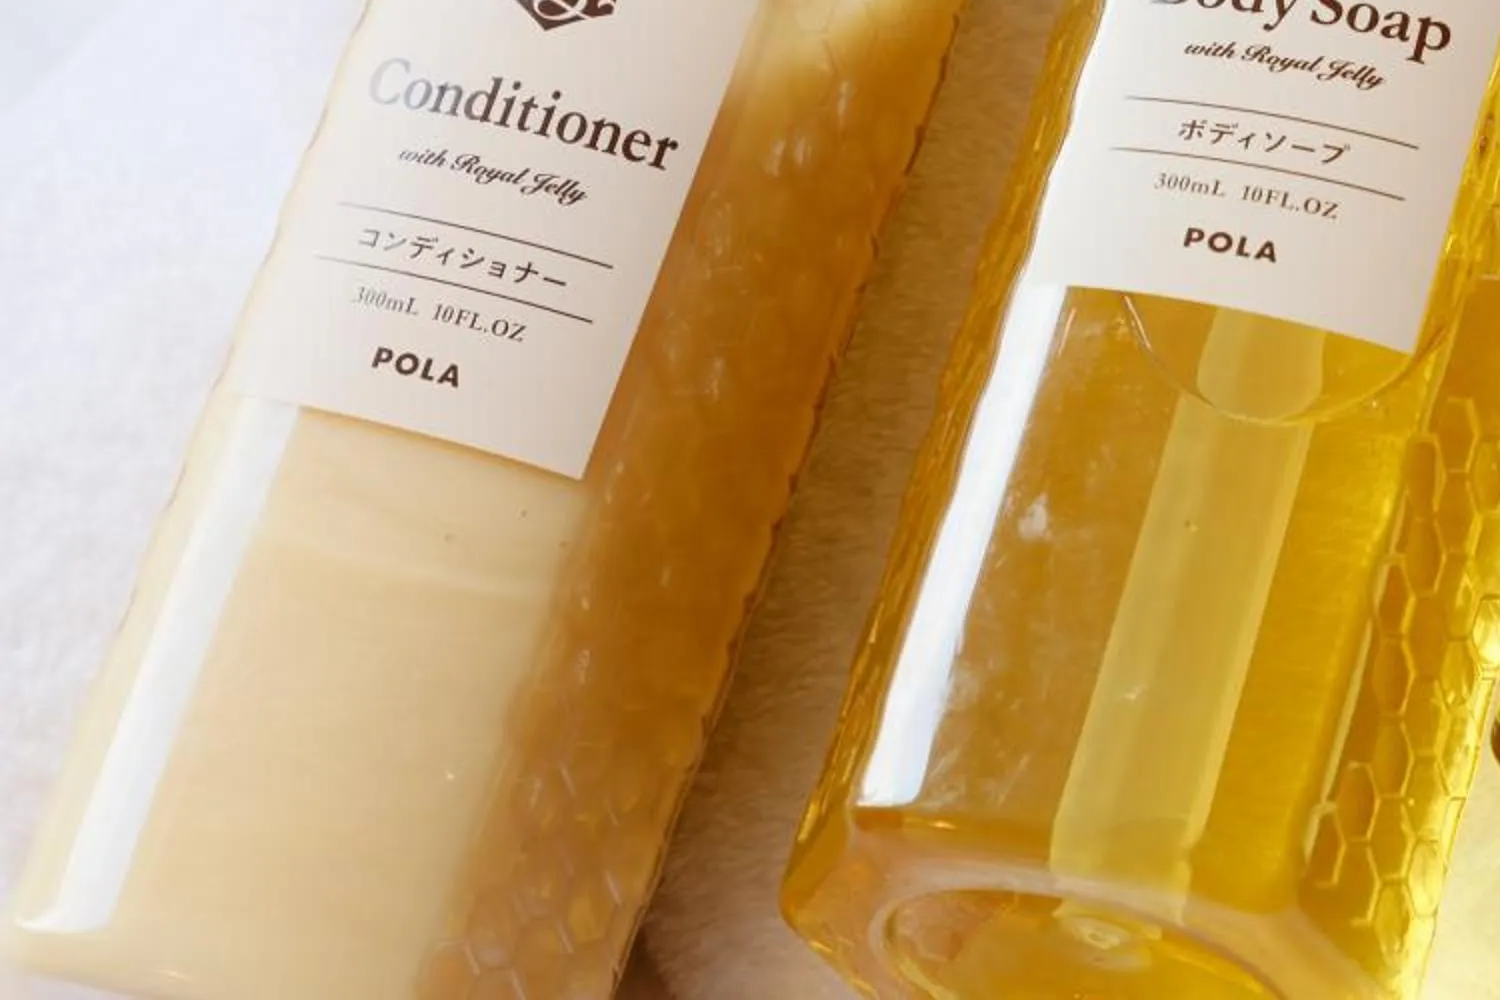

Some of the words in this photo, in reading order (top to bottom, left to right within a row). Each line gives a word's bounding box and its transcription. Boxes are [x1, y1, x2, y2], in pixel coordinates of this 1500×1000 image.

[1184, 38, 1239, 60] with
[1241, 44, 1323, 73] Royal
[1316, 60, 1385, 89] Jelly
[368, 57, 680, 171] Conditioner
[1178, 118, 1352, 165] ボディソープ
[398, 145, 448, 170] with
[450, 153, 524, 186] Royal
[520, 171, 588, 205] Jelly
[1154, 172, 1226, 198] 300mL
[1241, 185, 1339, 220] 10FL.OZ
[357, 228, 567, 288] コンディショナー
[1184, 227, 1278, 263] POLA
[351, 285, 419, 317] 300mL
[433, 303, 527, 343] 10FL.OZ
[371, 346, 460, 388] POLA
